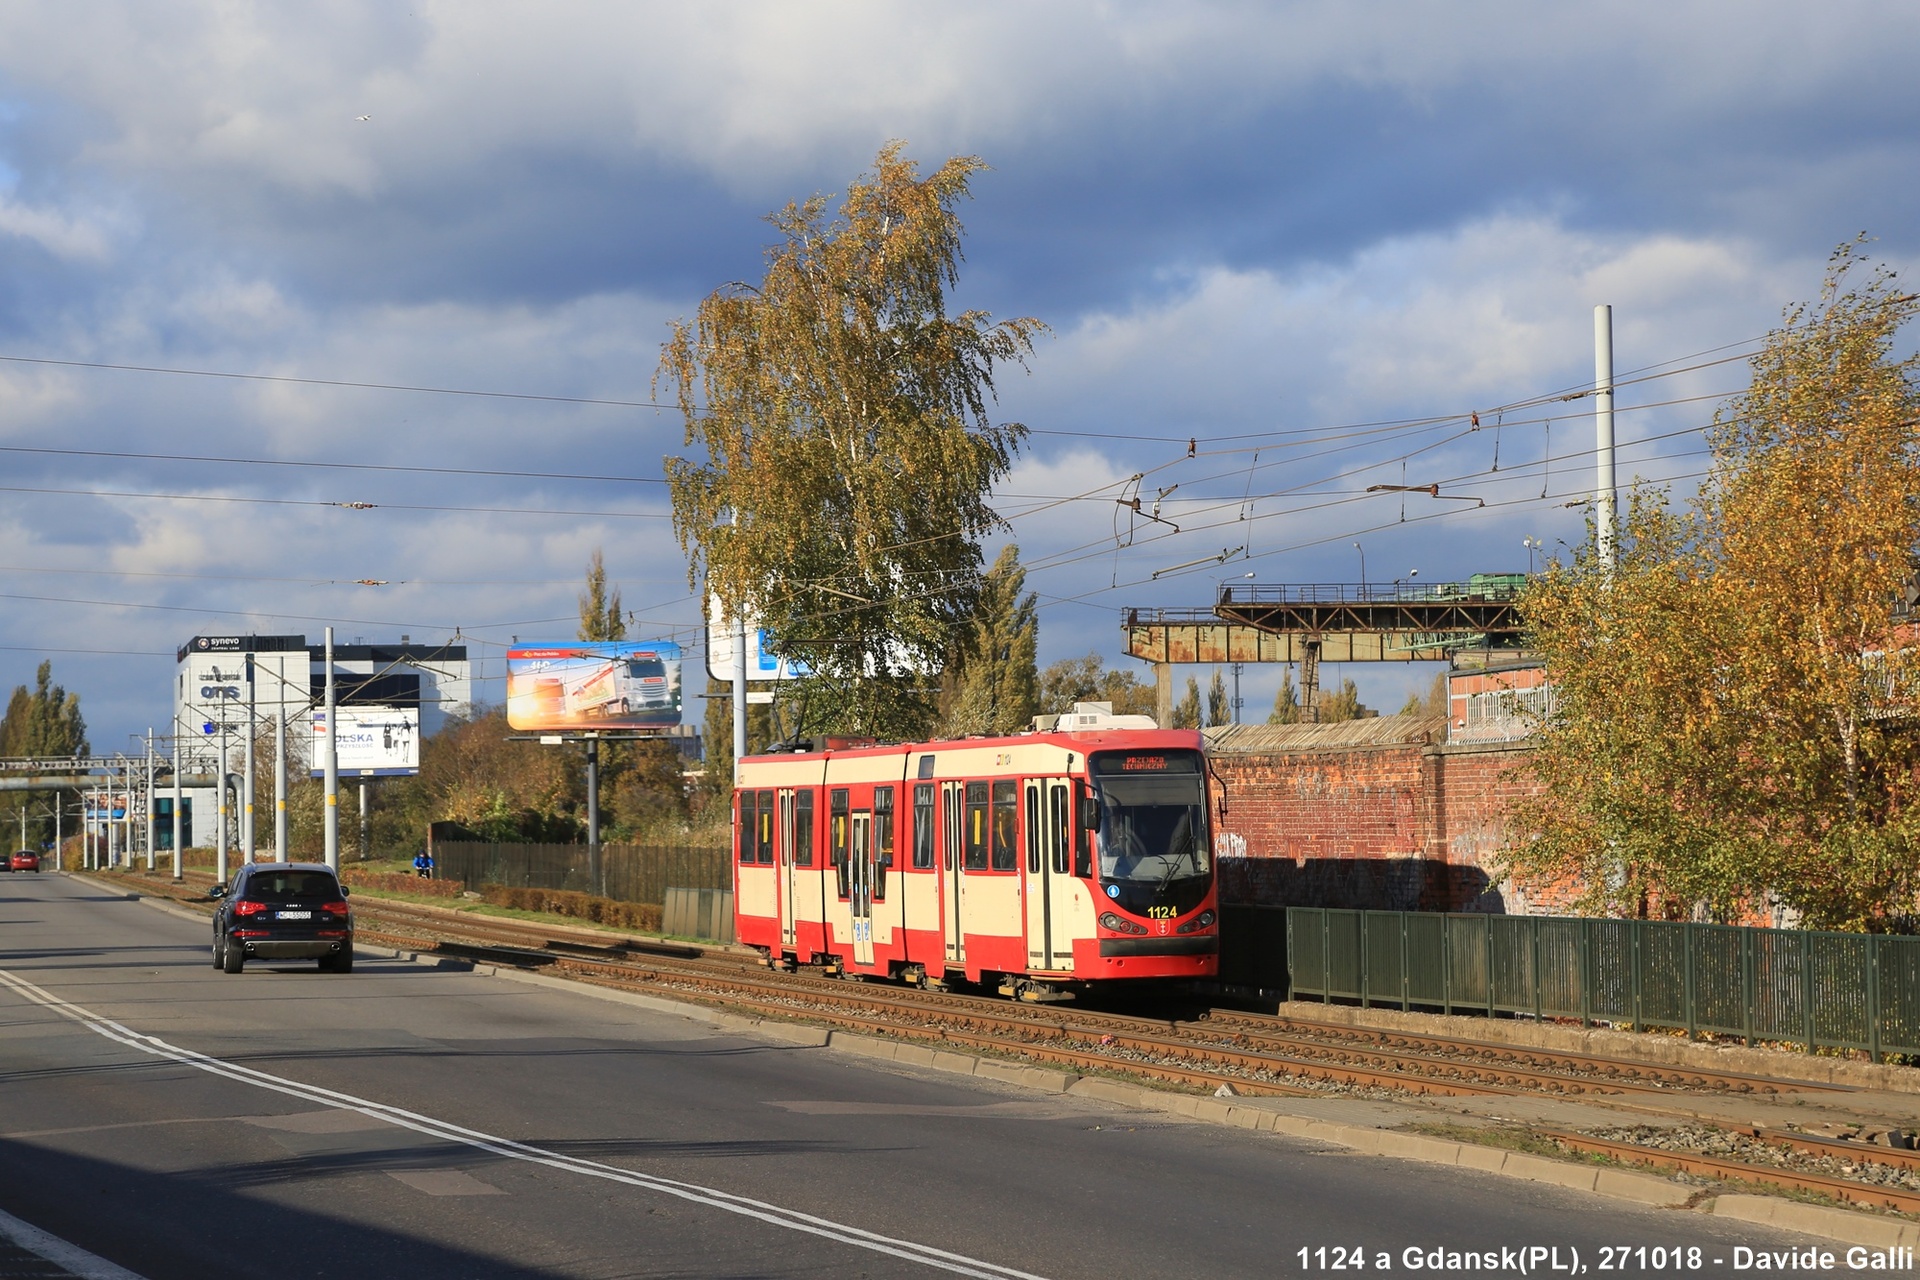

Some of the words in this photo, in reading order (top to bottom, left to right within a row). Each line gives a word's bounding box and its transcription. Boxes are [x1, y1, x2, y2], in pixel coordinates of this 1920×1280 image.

[211, 638, 239, 646] synevo
[335, 733, 374, 743] OLSKA
[1147, 906, 1177, 918] 1124
